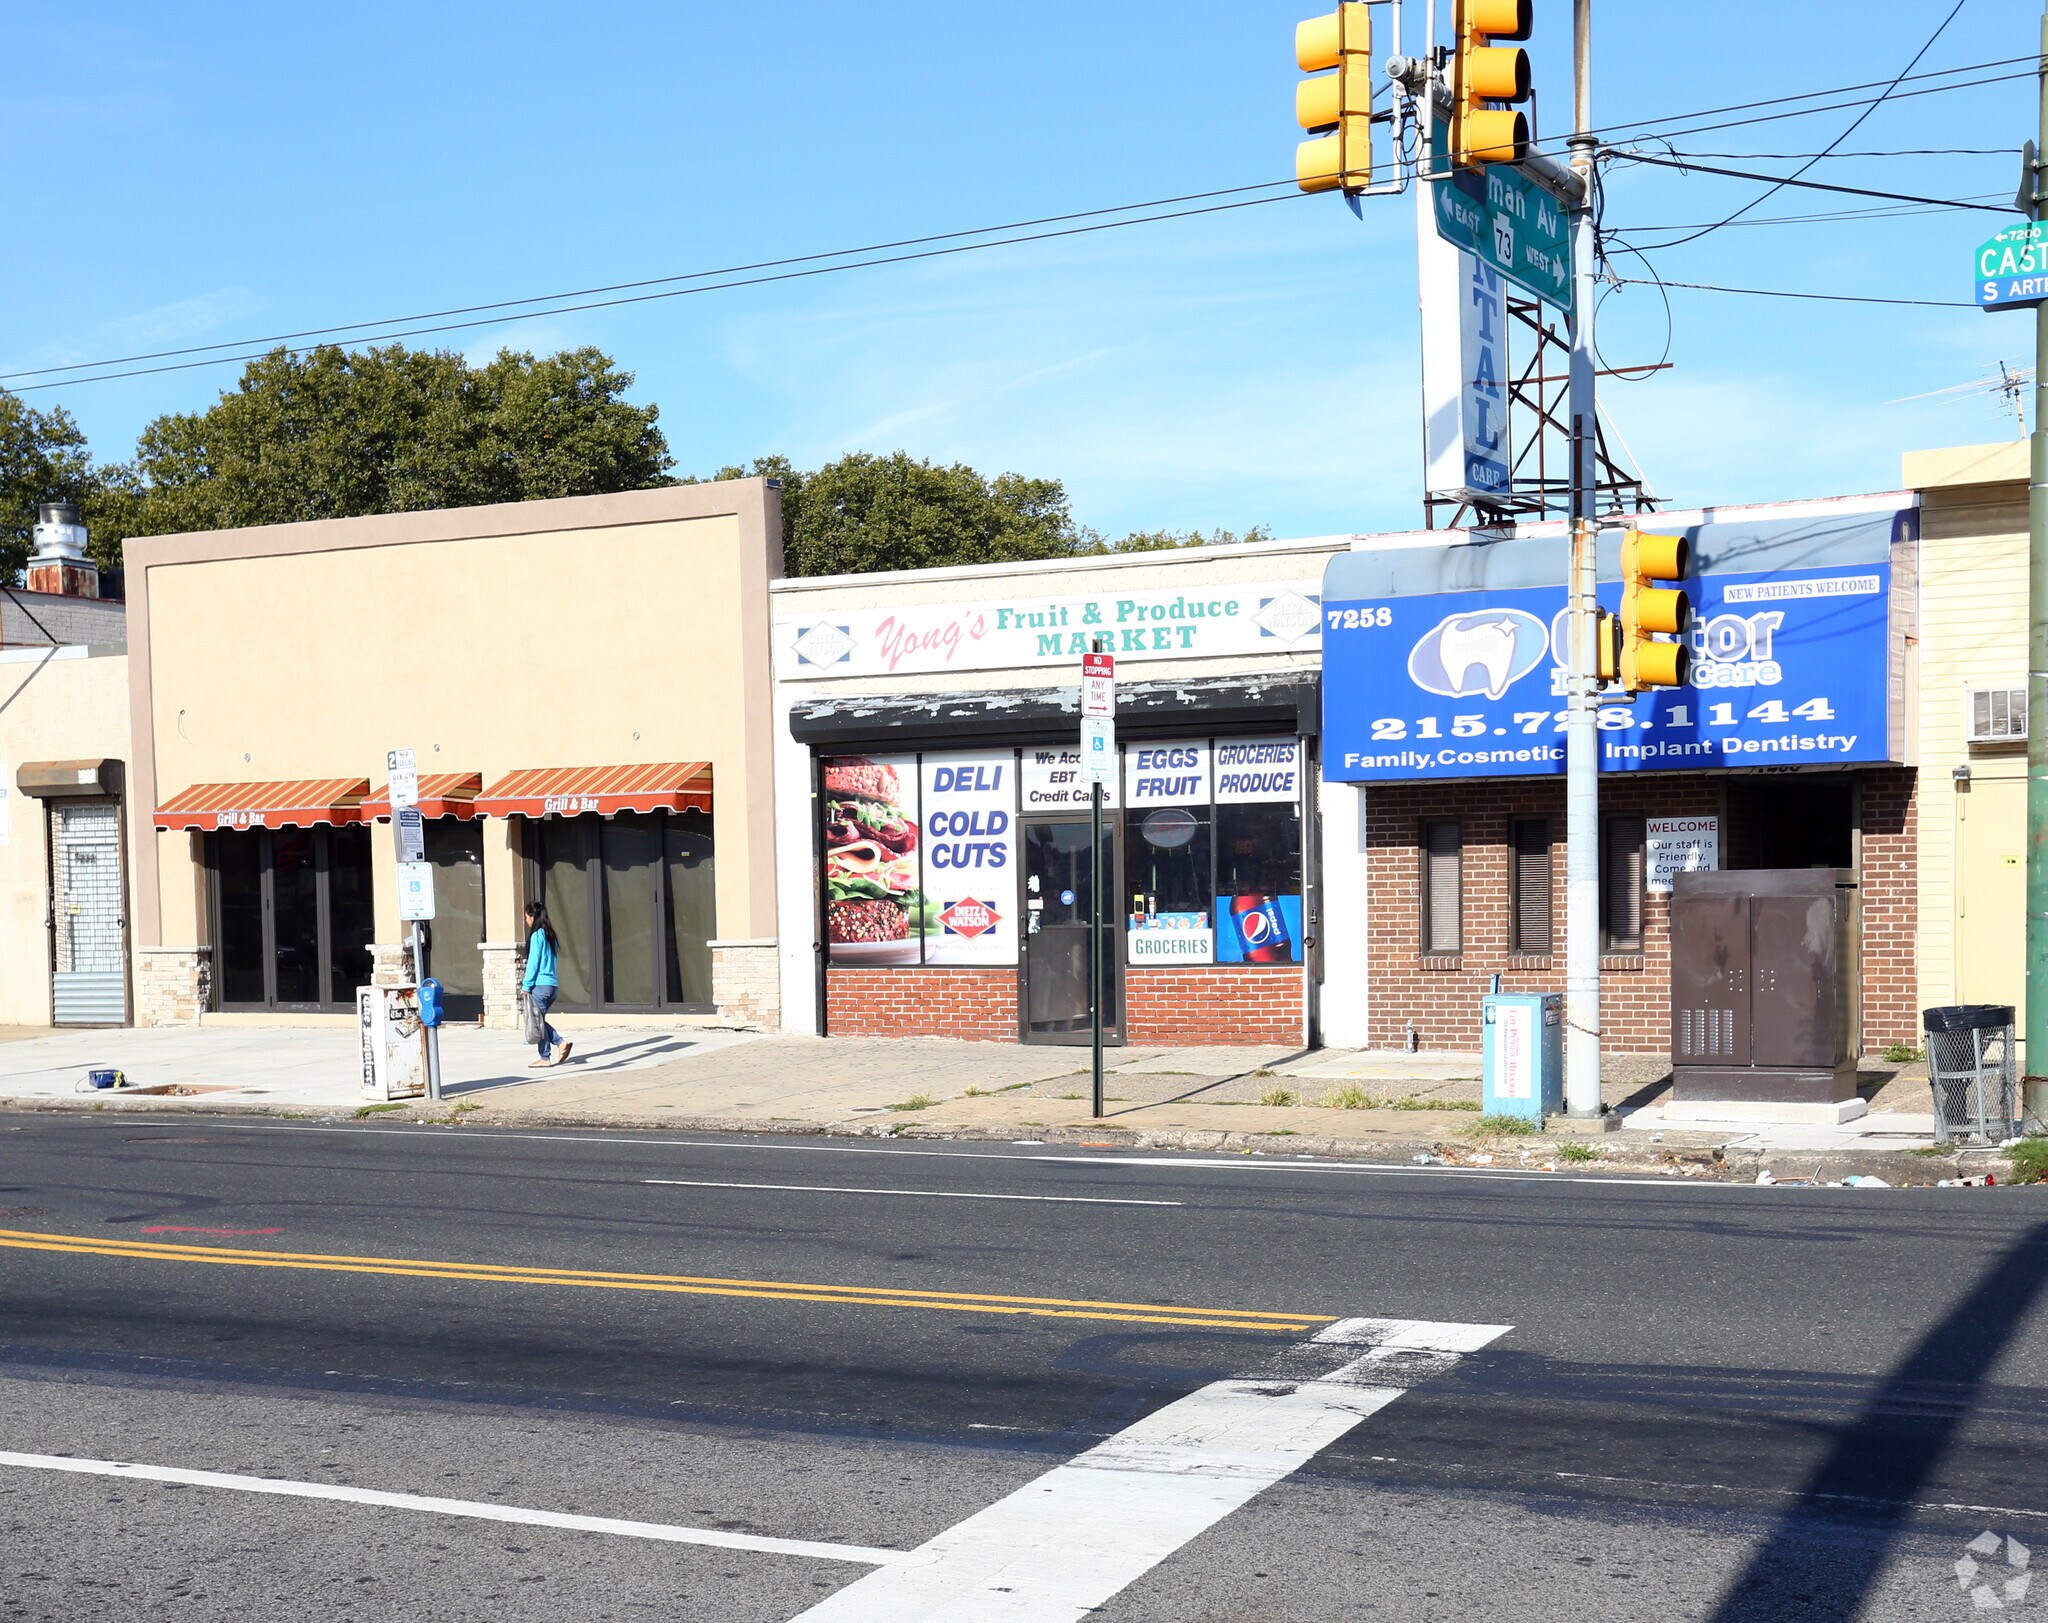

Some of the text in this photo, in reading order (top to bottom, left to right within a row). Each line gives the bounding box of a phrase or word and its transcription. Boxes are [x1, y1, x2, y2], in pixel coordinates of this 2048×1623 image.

[1455, 203, 1480, 234] EAST
[1536, 198, 1557, 239] Av
[1495, 228, 1512, 260] 73
[2008, 227, 2042, 242] 7200
[1526, 244, 1549, 273] WEST
[1983, 278, 2048, 301] S ART
[1472, 463, 1500, 488] CARE
[1728, 579, 1877, 601] NEW PATIENTS WELCOME
[996, 596, 1240, 630] Fruit & Produce
[1265, 613, 1314, 628] WATSON
[1327, 606, 1393, 630] 7258
[874, 610, 989, 672] Yong's
[1036, 625, 1198, 657] MARKET
[1085, 666, 1112, 676] STOPPING
[1093, 656, 1102, 665] NO
[1090, 680, 1105, 690] ANY
[1090, 691, 1106, 702] TIME
[1218, 743, 1296, 766] GROCERIES
[1606, 739, 1713, 761] Implant
[1722, 733, 1858, 753] Dentistry
[389, 753, 396, 768] 2
[1035, 752, 1055, 764] We
[1058, 752, 1081, 765] Acc
[1136, 747, 1199, 771] EGGS
[933, 765, 1003, 793] DELI
[1050, 771, 1077, 783] EBT
[1135, 775, 1202, 798] FRUIT
[1218, 772, 1295, 794] PRODUCE
[544, 797, 599, 812] Grill & Bar
[1029, 789, 1069, 802] Credit
[217, 812, 265, 825] Grill & Bar
[928, 810, 1009, 838] COLD
[1648, 821, 1717, 833] WELCOME
[931, 842, 1008, 869] CUTS
[1652, 839, 1713, 850] Our staff is
[1654, 863, 1711, 872] Come and
[1658, 852, 1706, 862] Friendly.
[1651, 877, 1673, 885] mee
[948, 916, 990, 928] WATSON
[1265, 908, 1281, 936] pepsi
[1135, 938, 1208, 955] GROCERIES
[362, 994, 371, 1022] The
[390, 1010, 403, 1019] The
[362, 1024, 375, 1087] Inquirer
